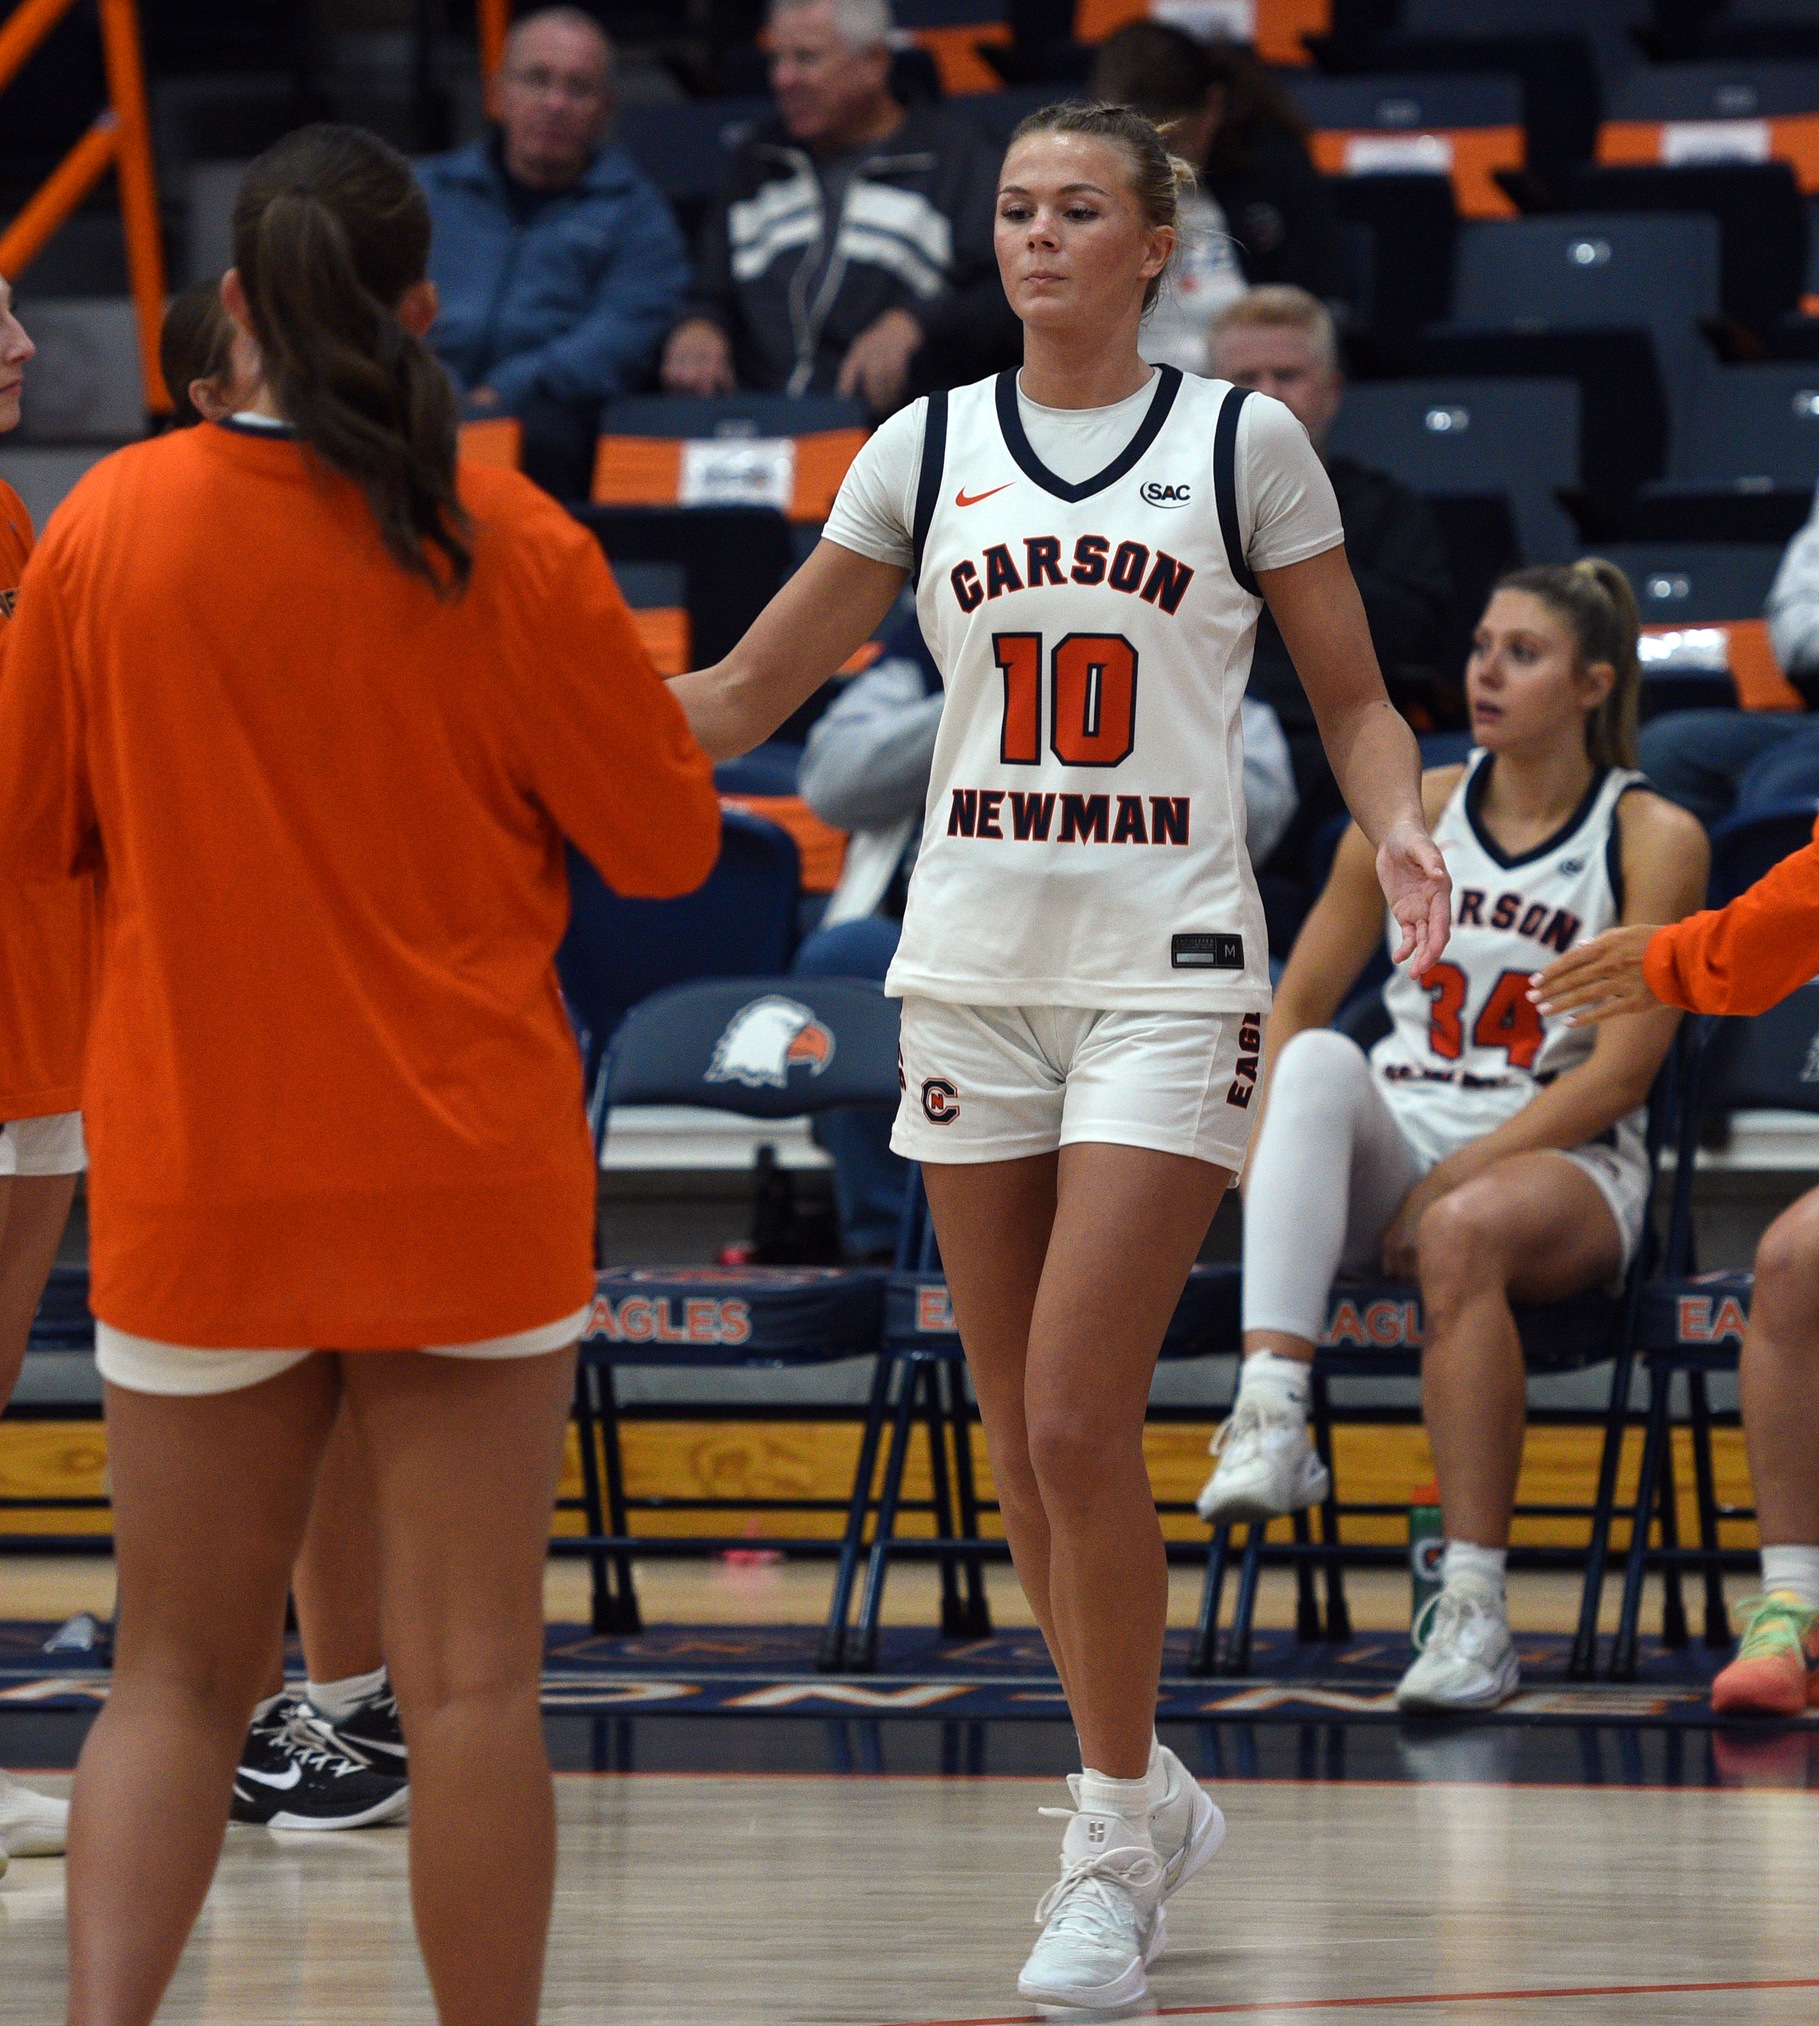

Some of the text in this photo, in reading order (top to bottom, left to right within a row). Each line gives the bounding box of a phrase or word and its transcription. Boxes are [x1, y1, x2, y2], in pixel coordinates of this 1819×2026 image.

[1147, 482, 1191, 501] SAC
[950, 534, 1195, 616] CARSON
[992, 631, 1139, 768] 10
[947, 788, 1190, 846] NEWMAN
[1455, 888, 1582, 955] RSON
[1224, 943, 1236, 959] M
[1419, 961, 1545, 1070] 34
[585, 1292, 752, 1345] AGLES
[1319, 1298, 1428, 1348] AGL
